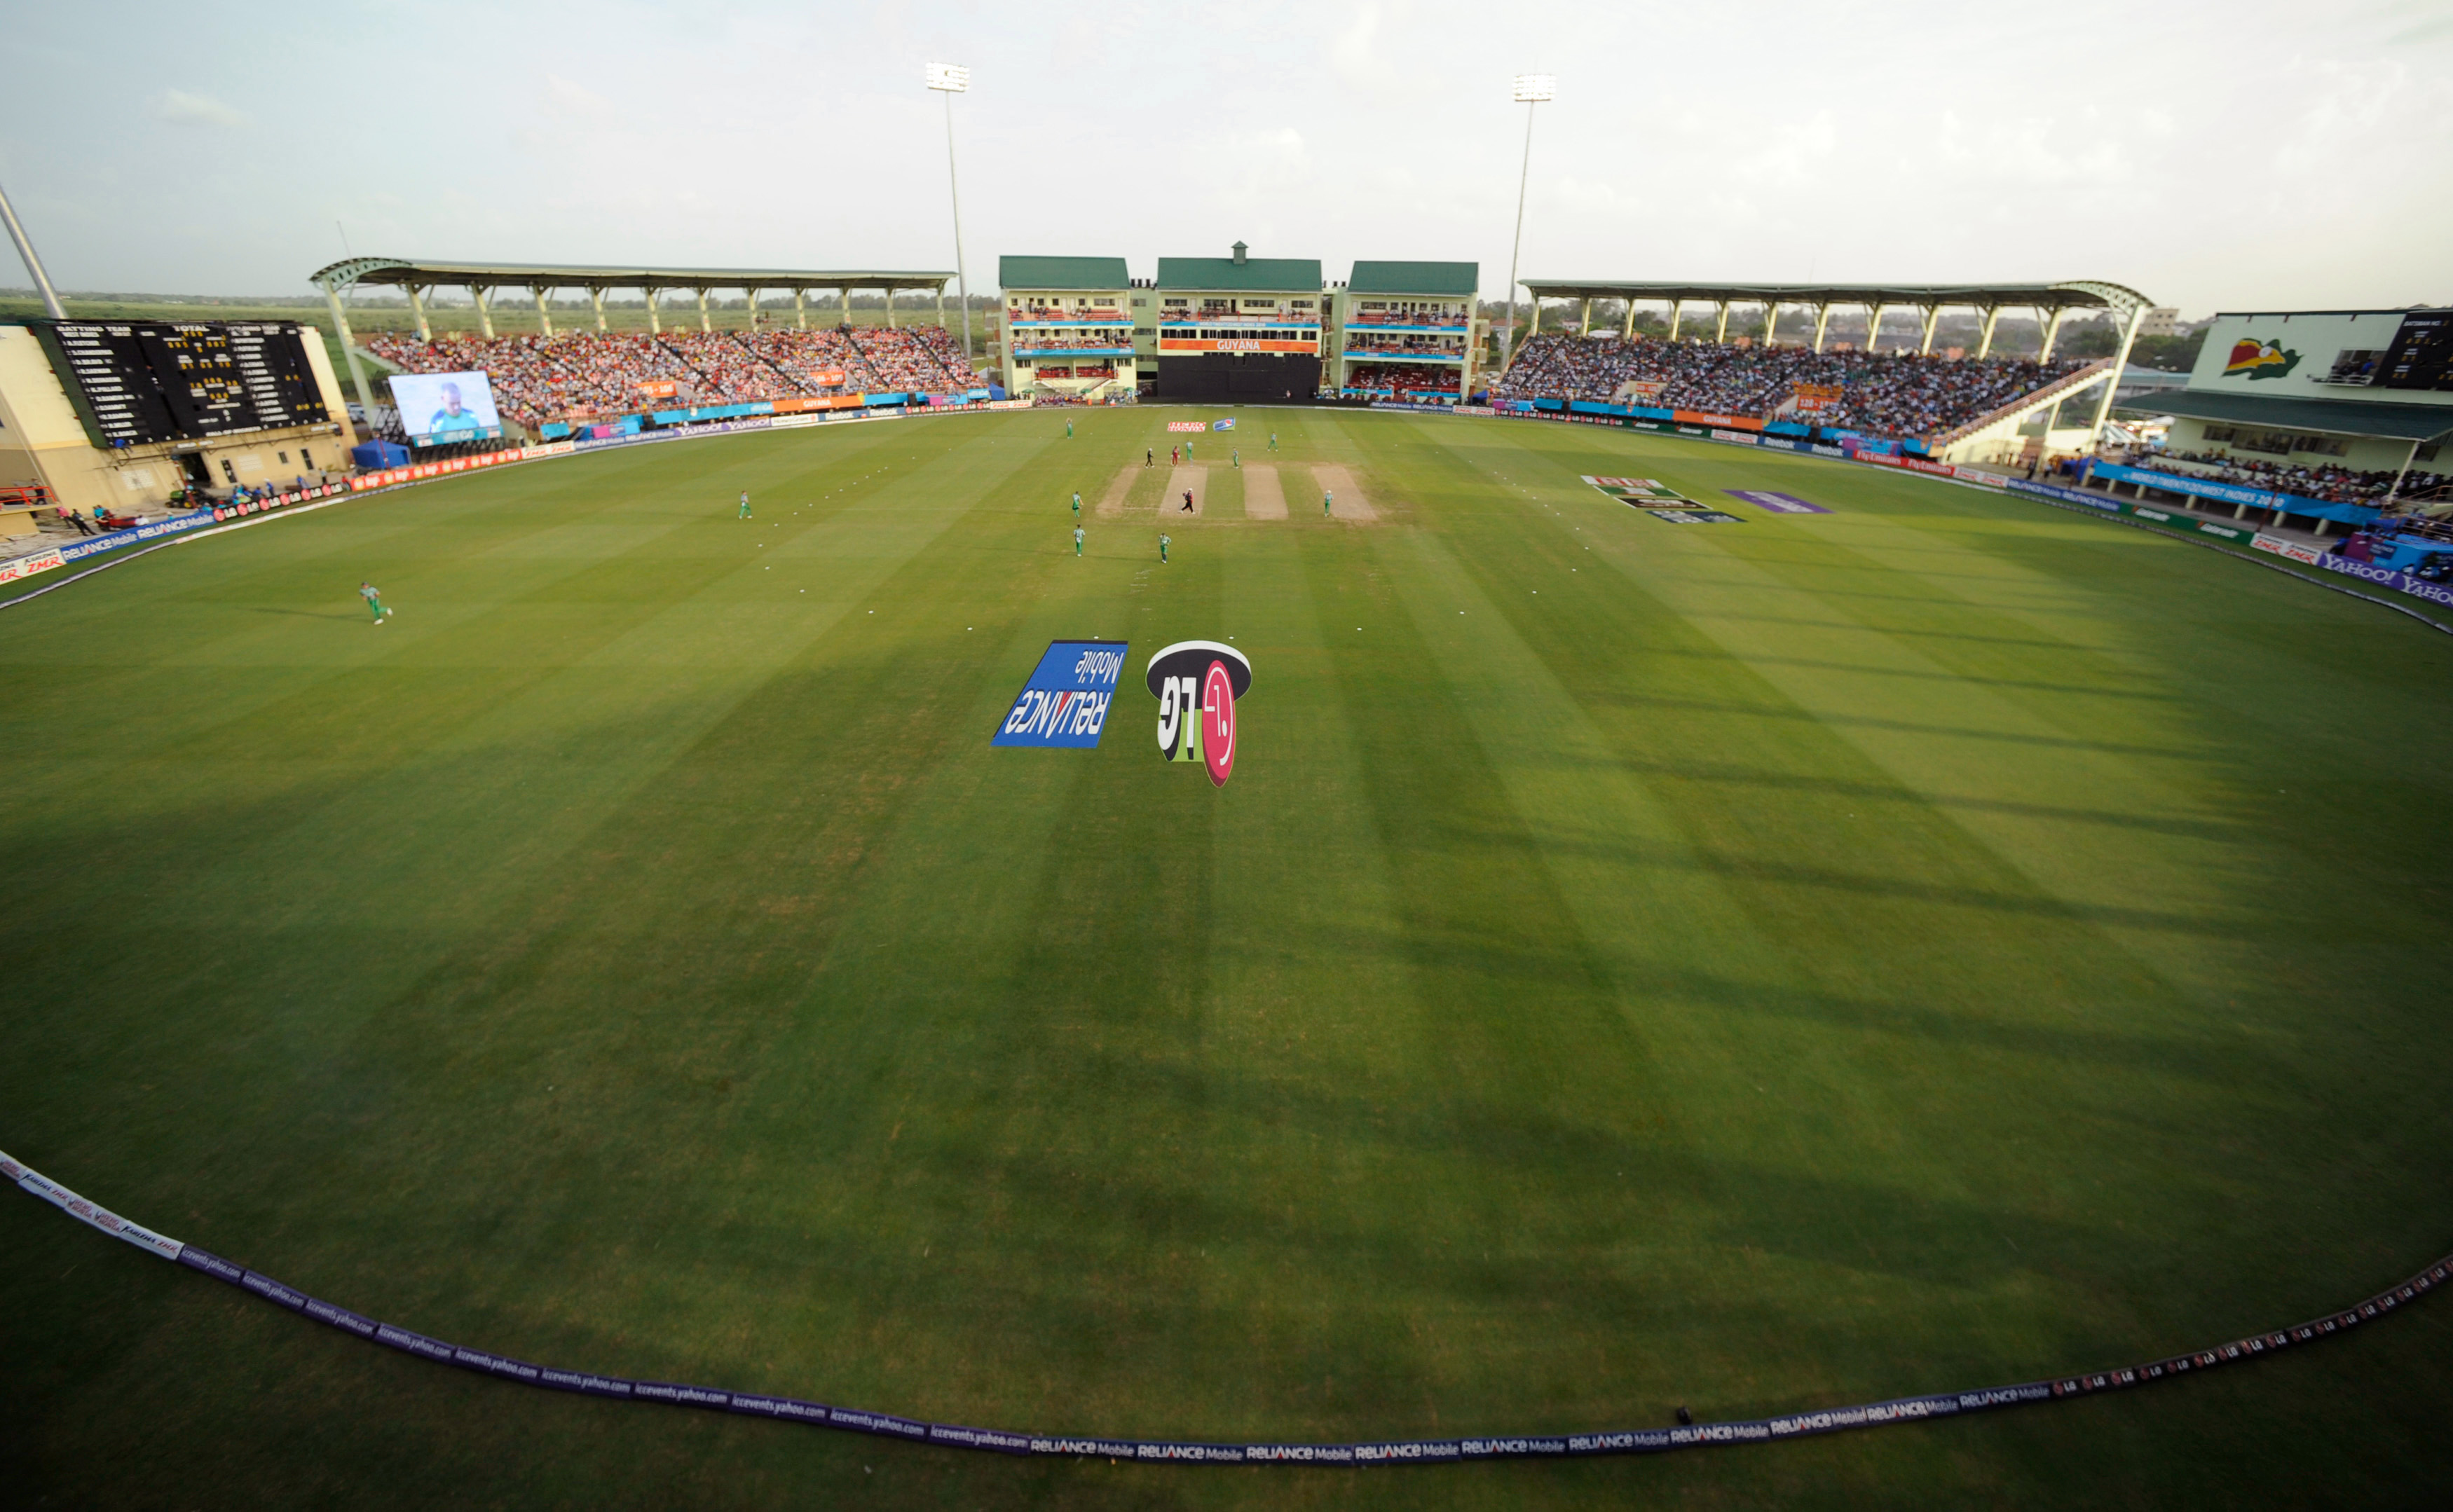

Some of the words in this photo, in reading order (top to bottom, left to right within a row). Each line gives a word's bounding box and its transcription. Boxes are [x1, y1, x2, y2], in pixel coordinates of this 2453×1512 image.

[1217, 340, 1260, 350] GUYANA
[826, 411, 854, 421] Reebok
[869, 407, 898, 416] Reebok
[726, 418, 770, 431] YAHOO!
[1703, 415, 1731, 425] GUYANA
[678, 423, 723, 436] YAHOO!
[1764, 437, 1794, 449] Reebok
[1812, 444, 1843, 456] Reebok
[1921, 462, 1951, 474] Emirates
[310, 488, 322, 498] LG
[331, 483, 343, 493] LG
[289, 492, 301, 502] LG
[2225, 488, 2257, 503] INDIES
[247, 502, 259, 513] LG
[269, 497, 281, 508] LG
[224, 507, 238, 518] LG
[137, 519, 187, 539] RELIANCE
[186, 514, 214, 528] Mobile
[62, 538, 113, 561] RELIANCE
[111, 532, 138, 548] Mobile
[2323, 554, 2396, 584] YAHOO!
[2400, 575, 2453, 605] YAHO
[1075, 650, 1124, 684] Mobile
[1005, 687, 1111, 739] RELIANCE
[1158, 675, 1196, 757] LG
[182, 1247, 240, 1279] iccevents.yahoo.com
[2434, 1267, 2446, 1279] LG
[2418, 1277, 2430, 1288] LG
[243, 1272, 304, 1307] iccevents.yahoo.com
[2402, 1286, 2414, 1298] LG
[2384, 1295, 2396, 1307] LG
[306, 1298, 373, 1335] iccevents.yahoo.com
[2364, 1305, 2377, 1316] LG
[2345, 1313, 2358, 1325] LG
[2323, 1320, 2336, 1332] LG
[2274, 1333, 2288, 1346] LG
[2299, 1328, 2313, 1340] LG
[377, 1324, 451, 1359] iccevents.yahoo.com
[2250, 1340, 2264, 1352] LG
[2203, 1352, 2216, 1365] LG
[2226, 1346, 2240, 1359] LG
[456, 1347, 538, 1379] iccevents.yahoo.com
[2176, 1359, 2189, 1371] LG
[2121, 1370, 2135, 1382] LG
[2149, 1366, 2163, 1377] LG
[541, 1367, 631, 1394] iccevents.yahoo.com
[2063, 1380, 2077, 1393] LG
[2092, 1375, 2106, 1387] LG
[635, 1382, 727, 1405] iccevents.yahoo.com
[1960, 1389, 2018, 1409] RELIANCE
[2018, 1385, 2050, 1400] Mobile
[732, 1394, 826, 1419] iccevents.yahoo.com
[1868, 1401, 1927, 1422] RELIANCE
[1926, 1400, 1960, 1413] Mobile
[830, 1408, 924, 1436] iccevents.yahoo.com
[1770, 1413, 1832, 1435] RELIANCE
[1832, 1406, 1867, 1425] Mobile
[931, 1424, 1028, 1449] iccevents.yahoo.com
[1670, 1426, 1733, 1443] RELIANCE
[1733, 1424, 1770, 1438] Mobile
[1461, 1438, 1528, 1455] RELIANCE
[1529, 1439, 1566, 1453] Mobile
[1569, 1434, 1634, 1451] RELIANCE
[1634, 1431, 1669, 1447] Mobile
[1031, 1440, 1096, 1454] RELIANCE
[1097, 1443, 1135, 1457] Mobile
[1137, 1445, 1205, 1459] RELIANCE
[1205, 1447, 1243, 1462] Mobile
[1246, 1445, 1313, 1460] RELIANCE
[1314, 1447, 1352, 1462] Mobile
[1355, 1443, 1421, 1460] RELIANCE
[1422, 1442, 1459, 1457] Mobile
